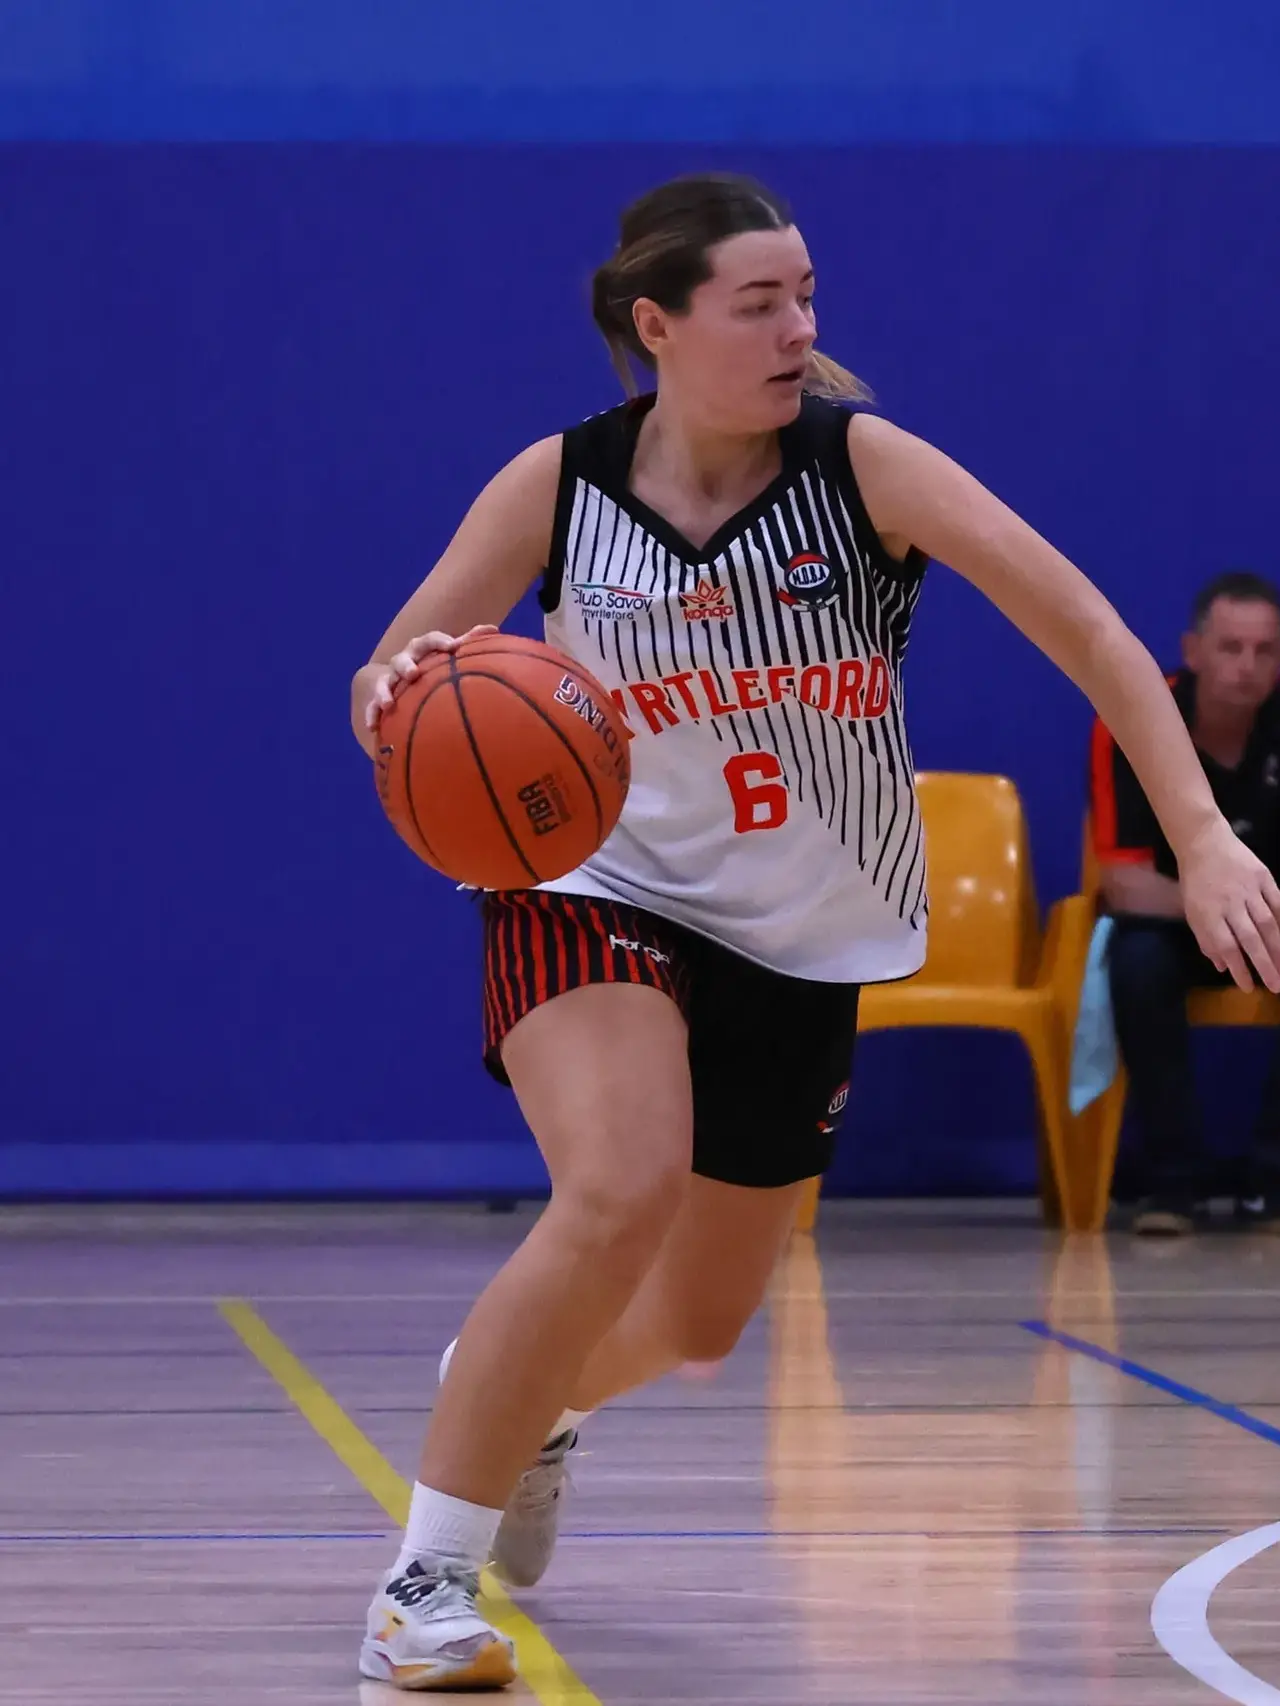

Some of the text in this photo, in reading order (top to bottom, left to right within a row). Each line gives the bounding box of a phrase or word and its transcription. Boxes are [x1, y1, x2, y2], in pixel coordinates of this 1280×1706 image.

[606, 592, 653, 612] Savoy
[608, 656, 891, 739] RTLEFORD
[722, 751, 789, 833] 6
